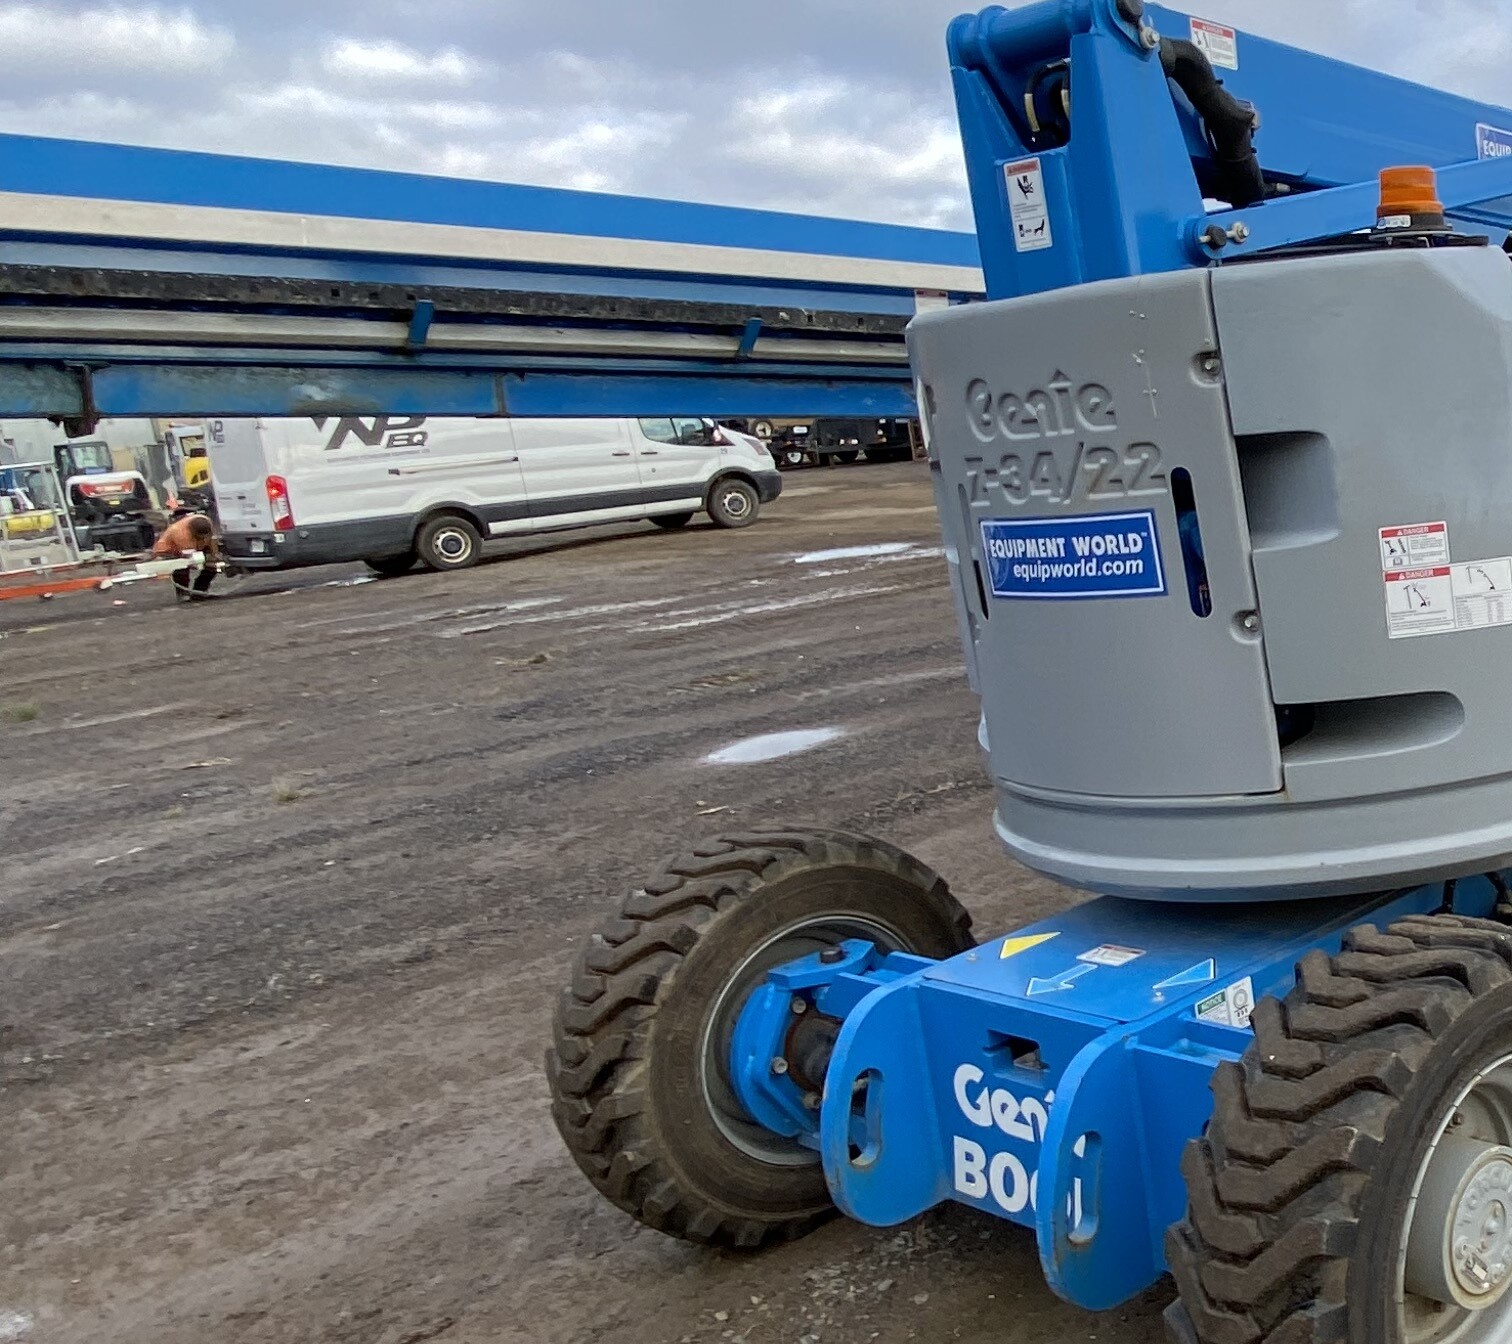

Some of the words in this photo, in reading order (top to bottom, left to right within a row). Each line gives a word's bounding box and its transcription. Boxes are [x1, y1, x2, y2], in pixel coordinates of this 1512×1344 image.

[965, 367, 1118, 443] Genie
[965, 442, 1168, 507] Z-34/22
[1403, 526, 1429, 536] DANGER
[989, 537, 1066, 559] EQUIPMENT
[1013, 558, 1144, 582] equipworld.com
[1406, 569, 1434, 579] DANGER
[1201, 993, 1223, 1012] NOTICE
